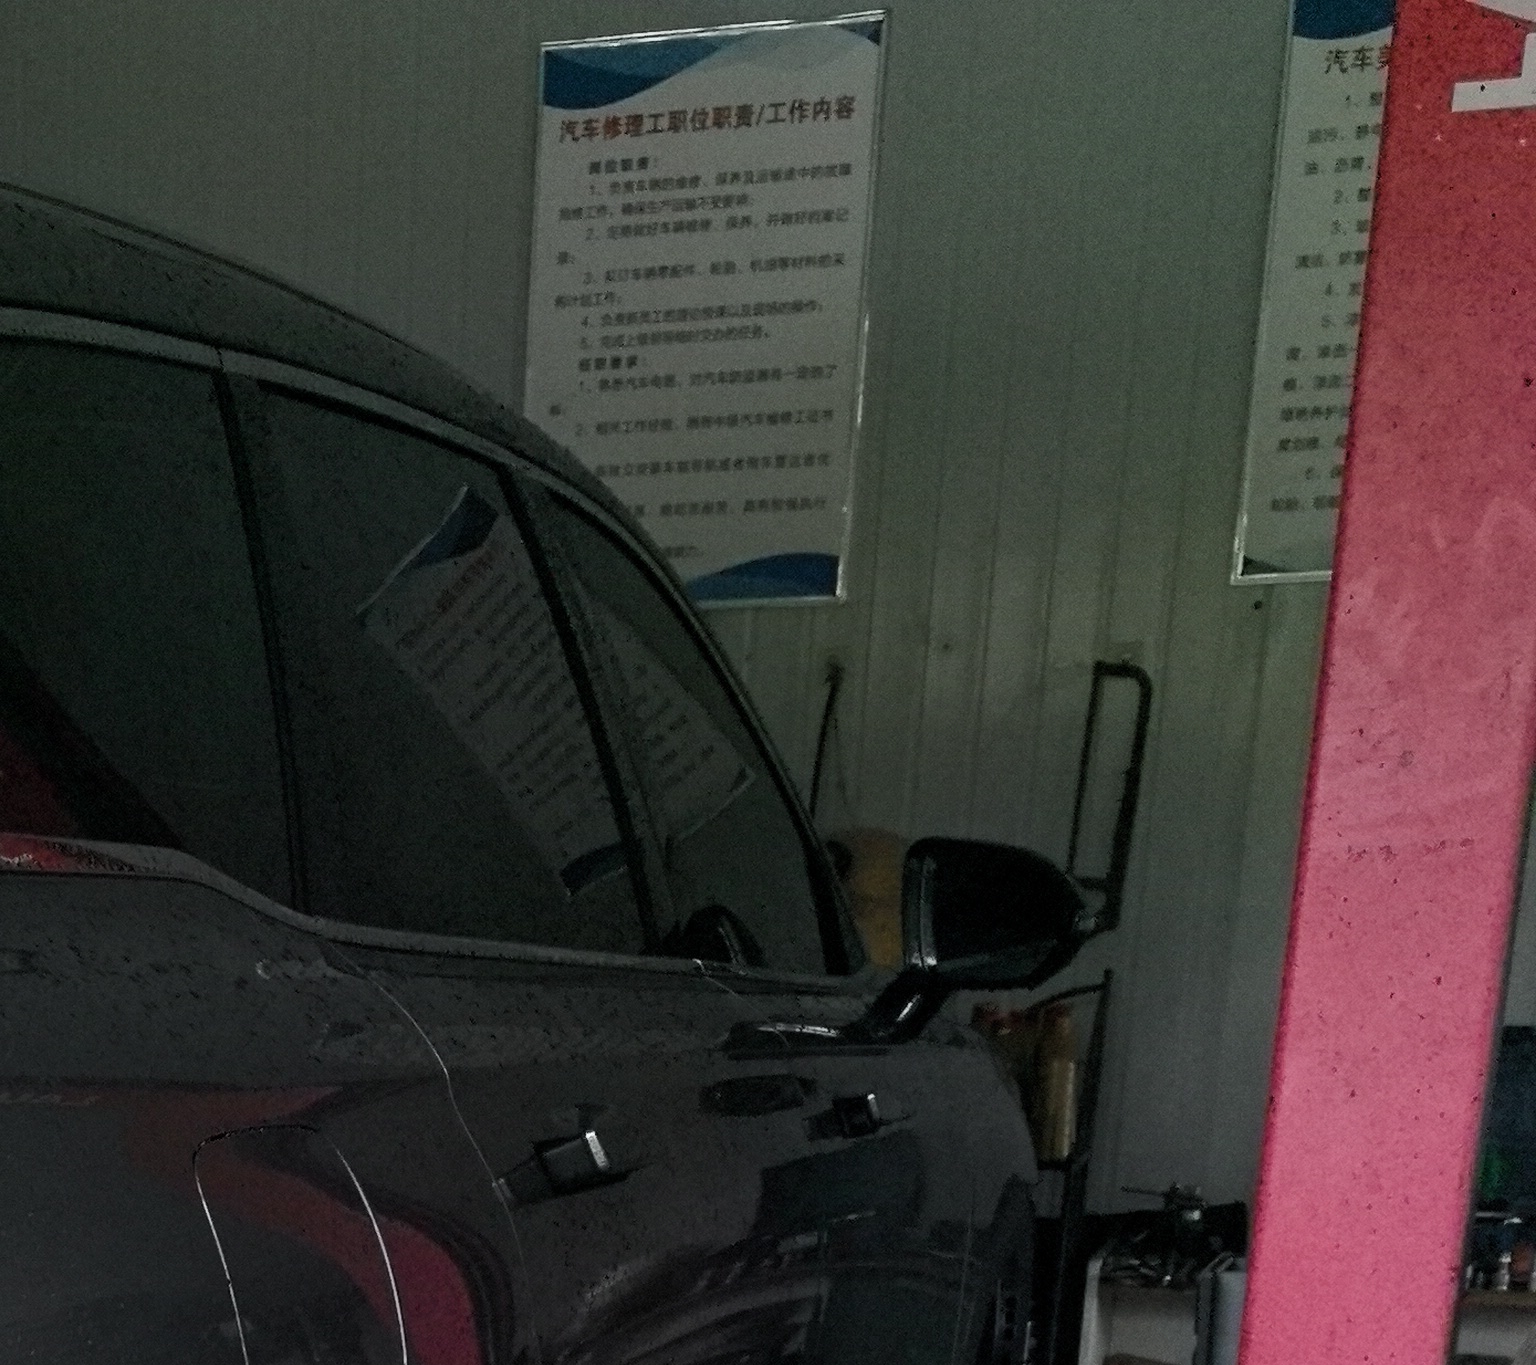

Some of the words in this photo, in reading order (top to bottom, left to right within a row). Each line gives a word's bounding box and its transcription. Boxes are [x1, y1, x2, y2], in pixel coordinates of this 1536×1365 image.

[559, 96, 857, 142] 汽车修理工职位职责/工作内容
